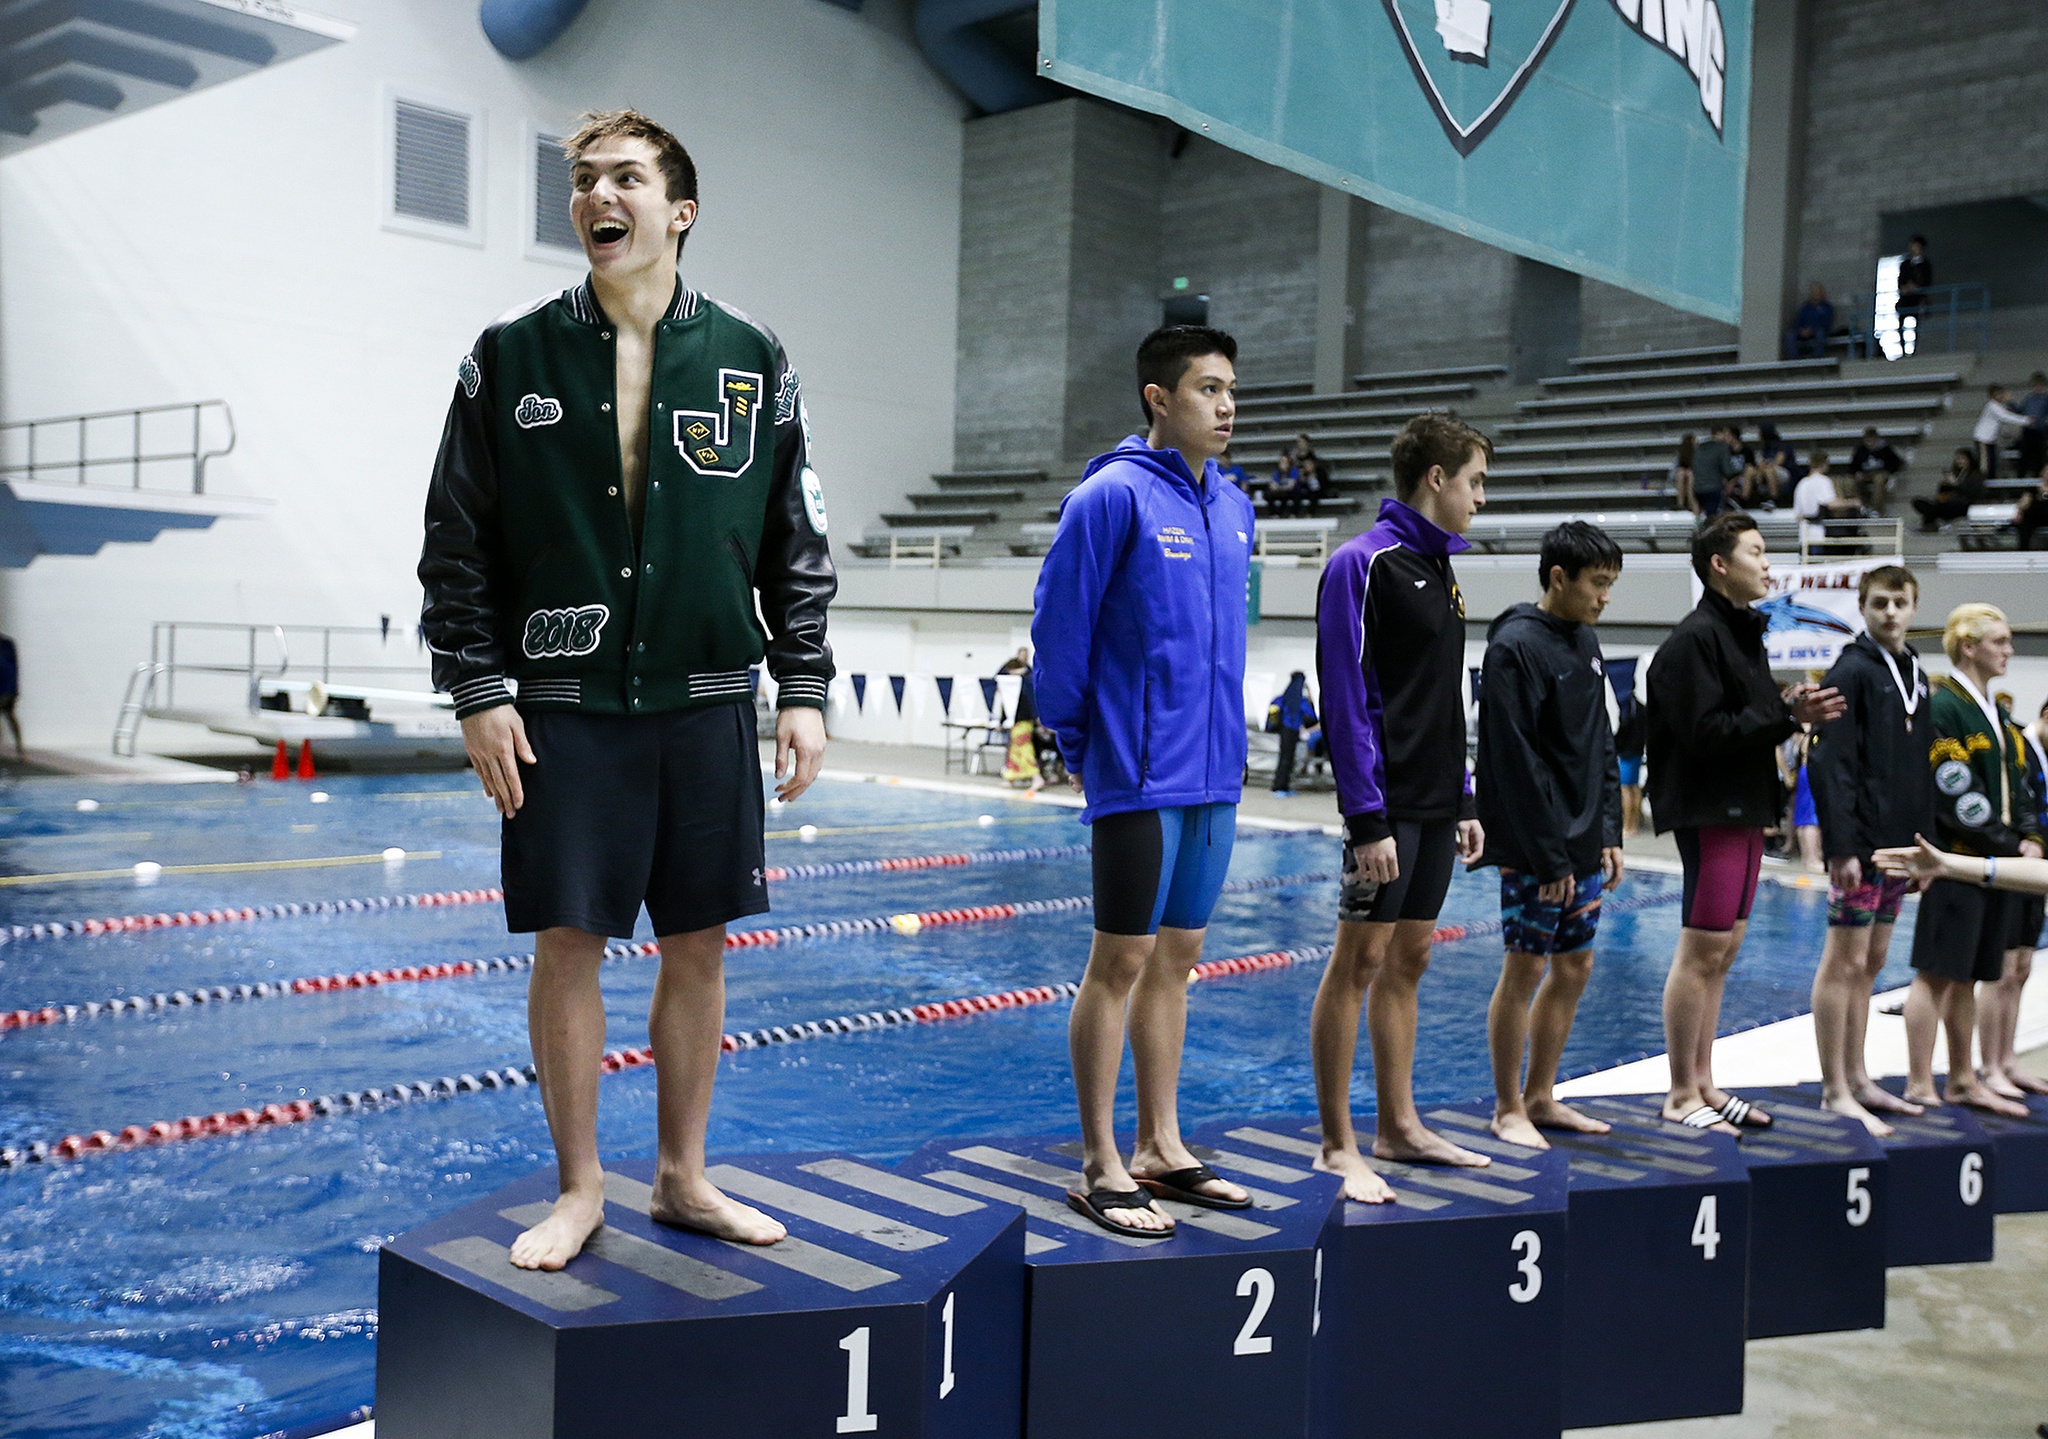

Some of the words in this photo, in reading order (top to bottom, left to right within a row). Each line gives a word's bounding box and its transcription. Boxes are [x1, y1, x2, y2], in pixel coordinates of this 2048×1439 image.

[518, 396, 559, 424] Jon
[673, 368, 763, 478] J
[526, 608, 606, 656] 2018
[1847, 1168, 1870, 1225] 5
[1960, 1153, 1982, 1204] 6
[1692, 1196, 1720, 1259] 4
[1509, 1231, 1541, 1302] 3
[1234, 1268, 1274, 1355] 2
[939, 1291, 955, 1400] 1
[836, 1327, 878, 1433] 1
